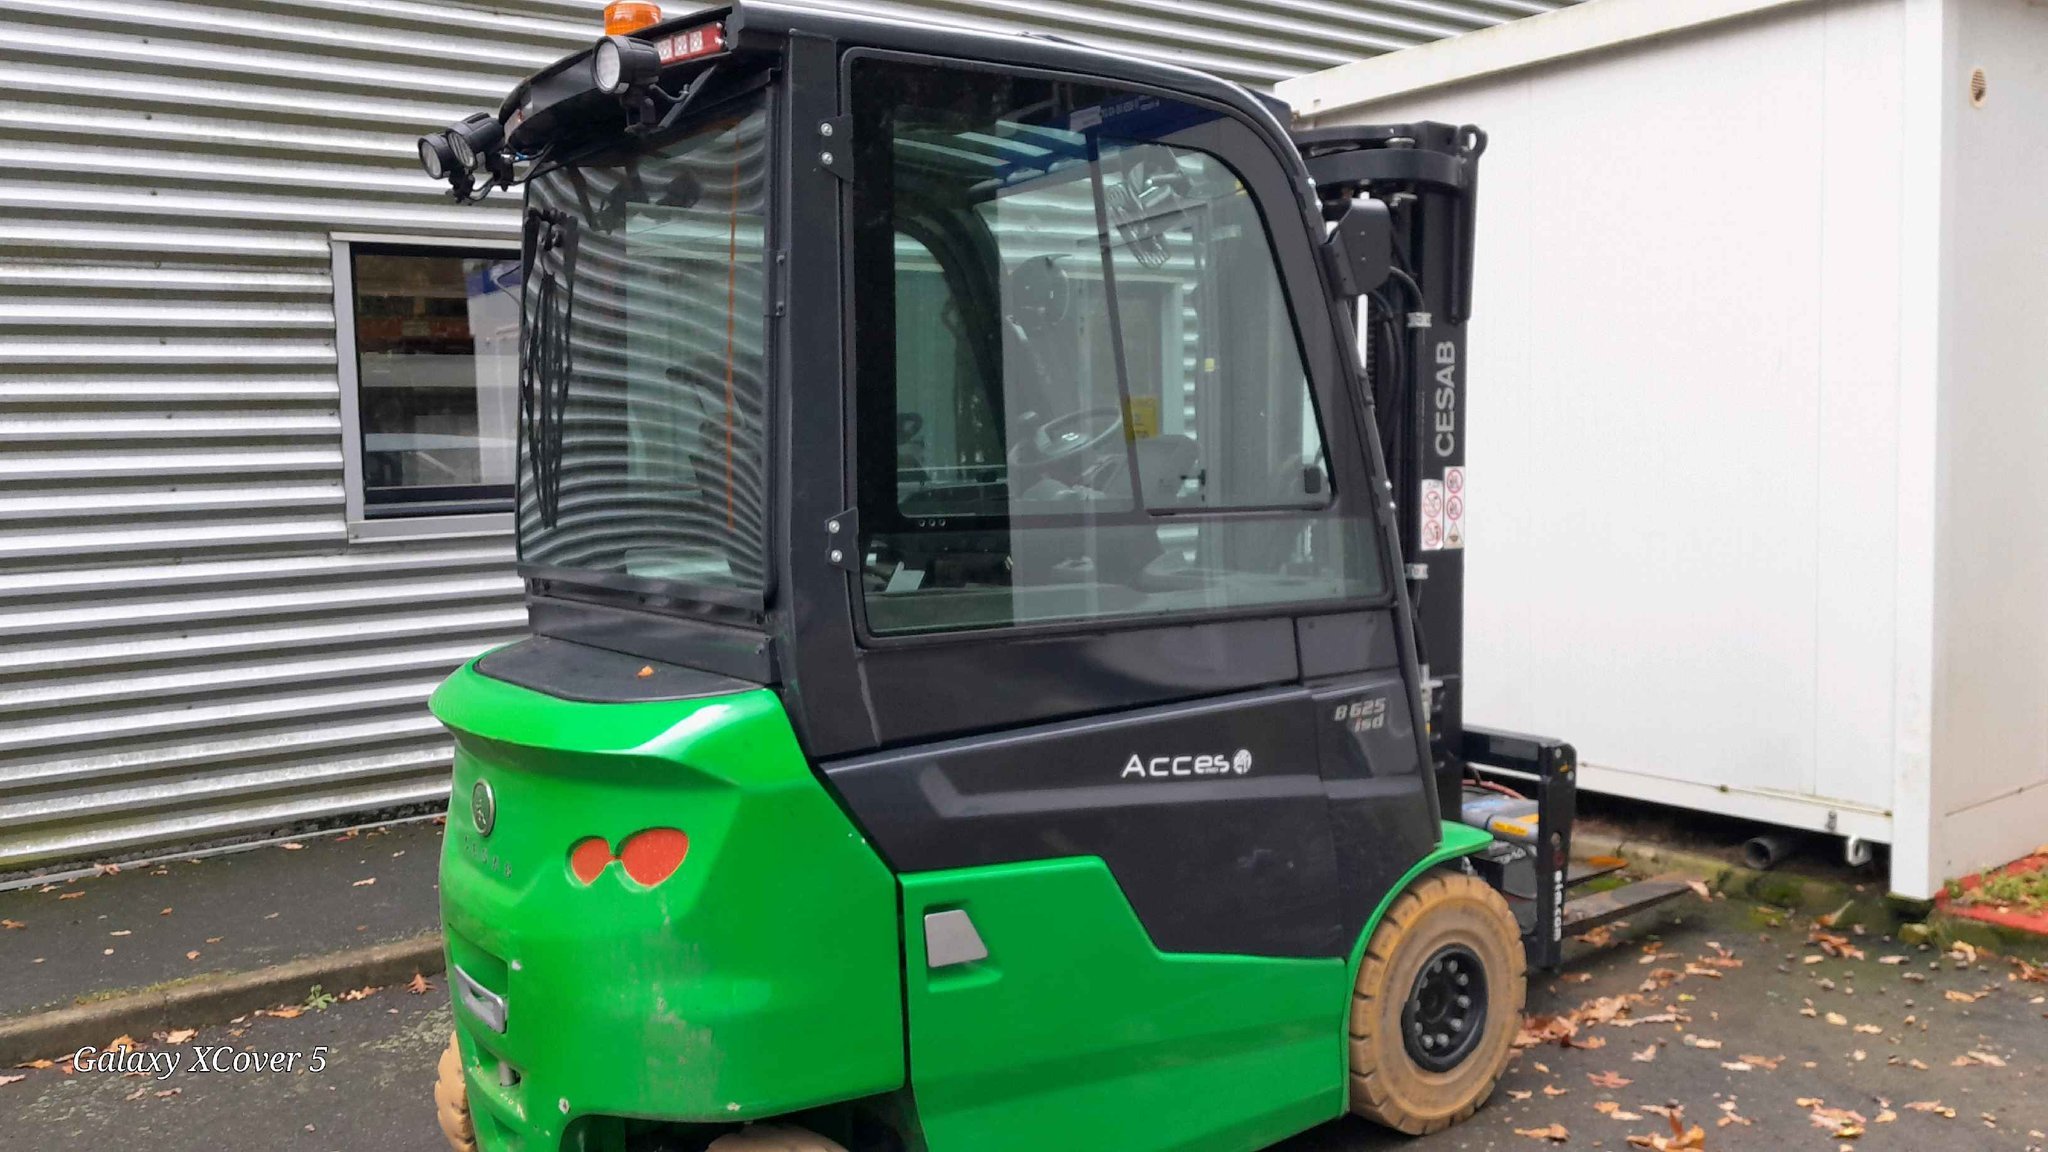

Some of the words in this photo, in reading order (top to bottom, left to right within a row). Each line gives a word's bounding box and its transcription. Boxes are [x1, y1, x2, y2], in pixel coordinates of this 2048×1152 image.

[1435, 341, 1456, 457] CESAB
[1121, 753, 1230, 778] Acces
[464, 835, 512, 879] SAB
